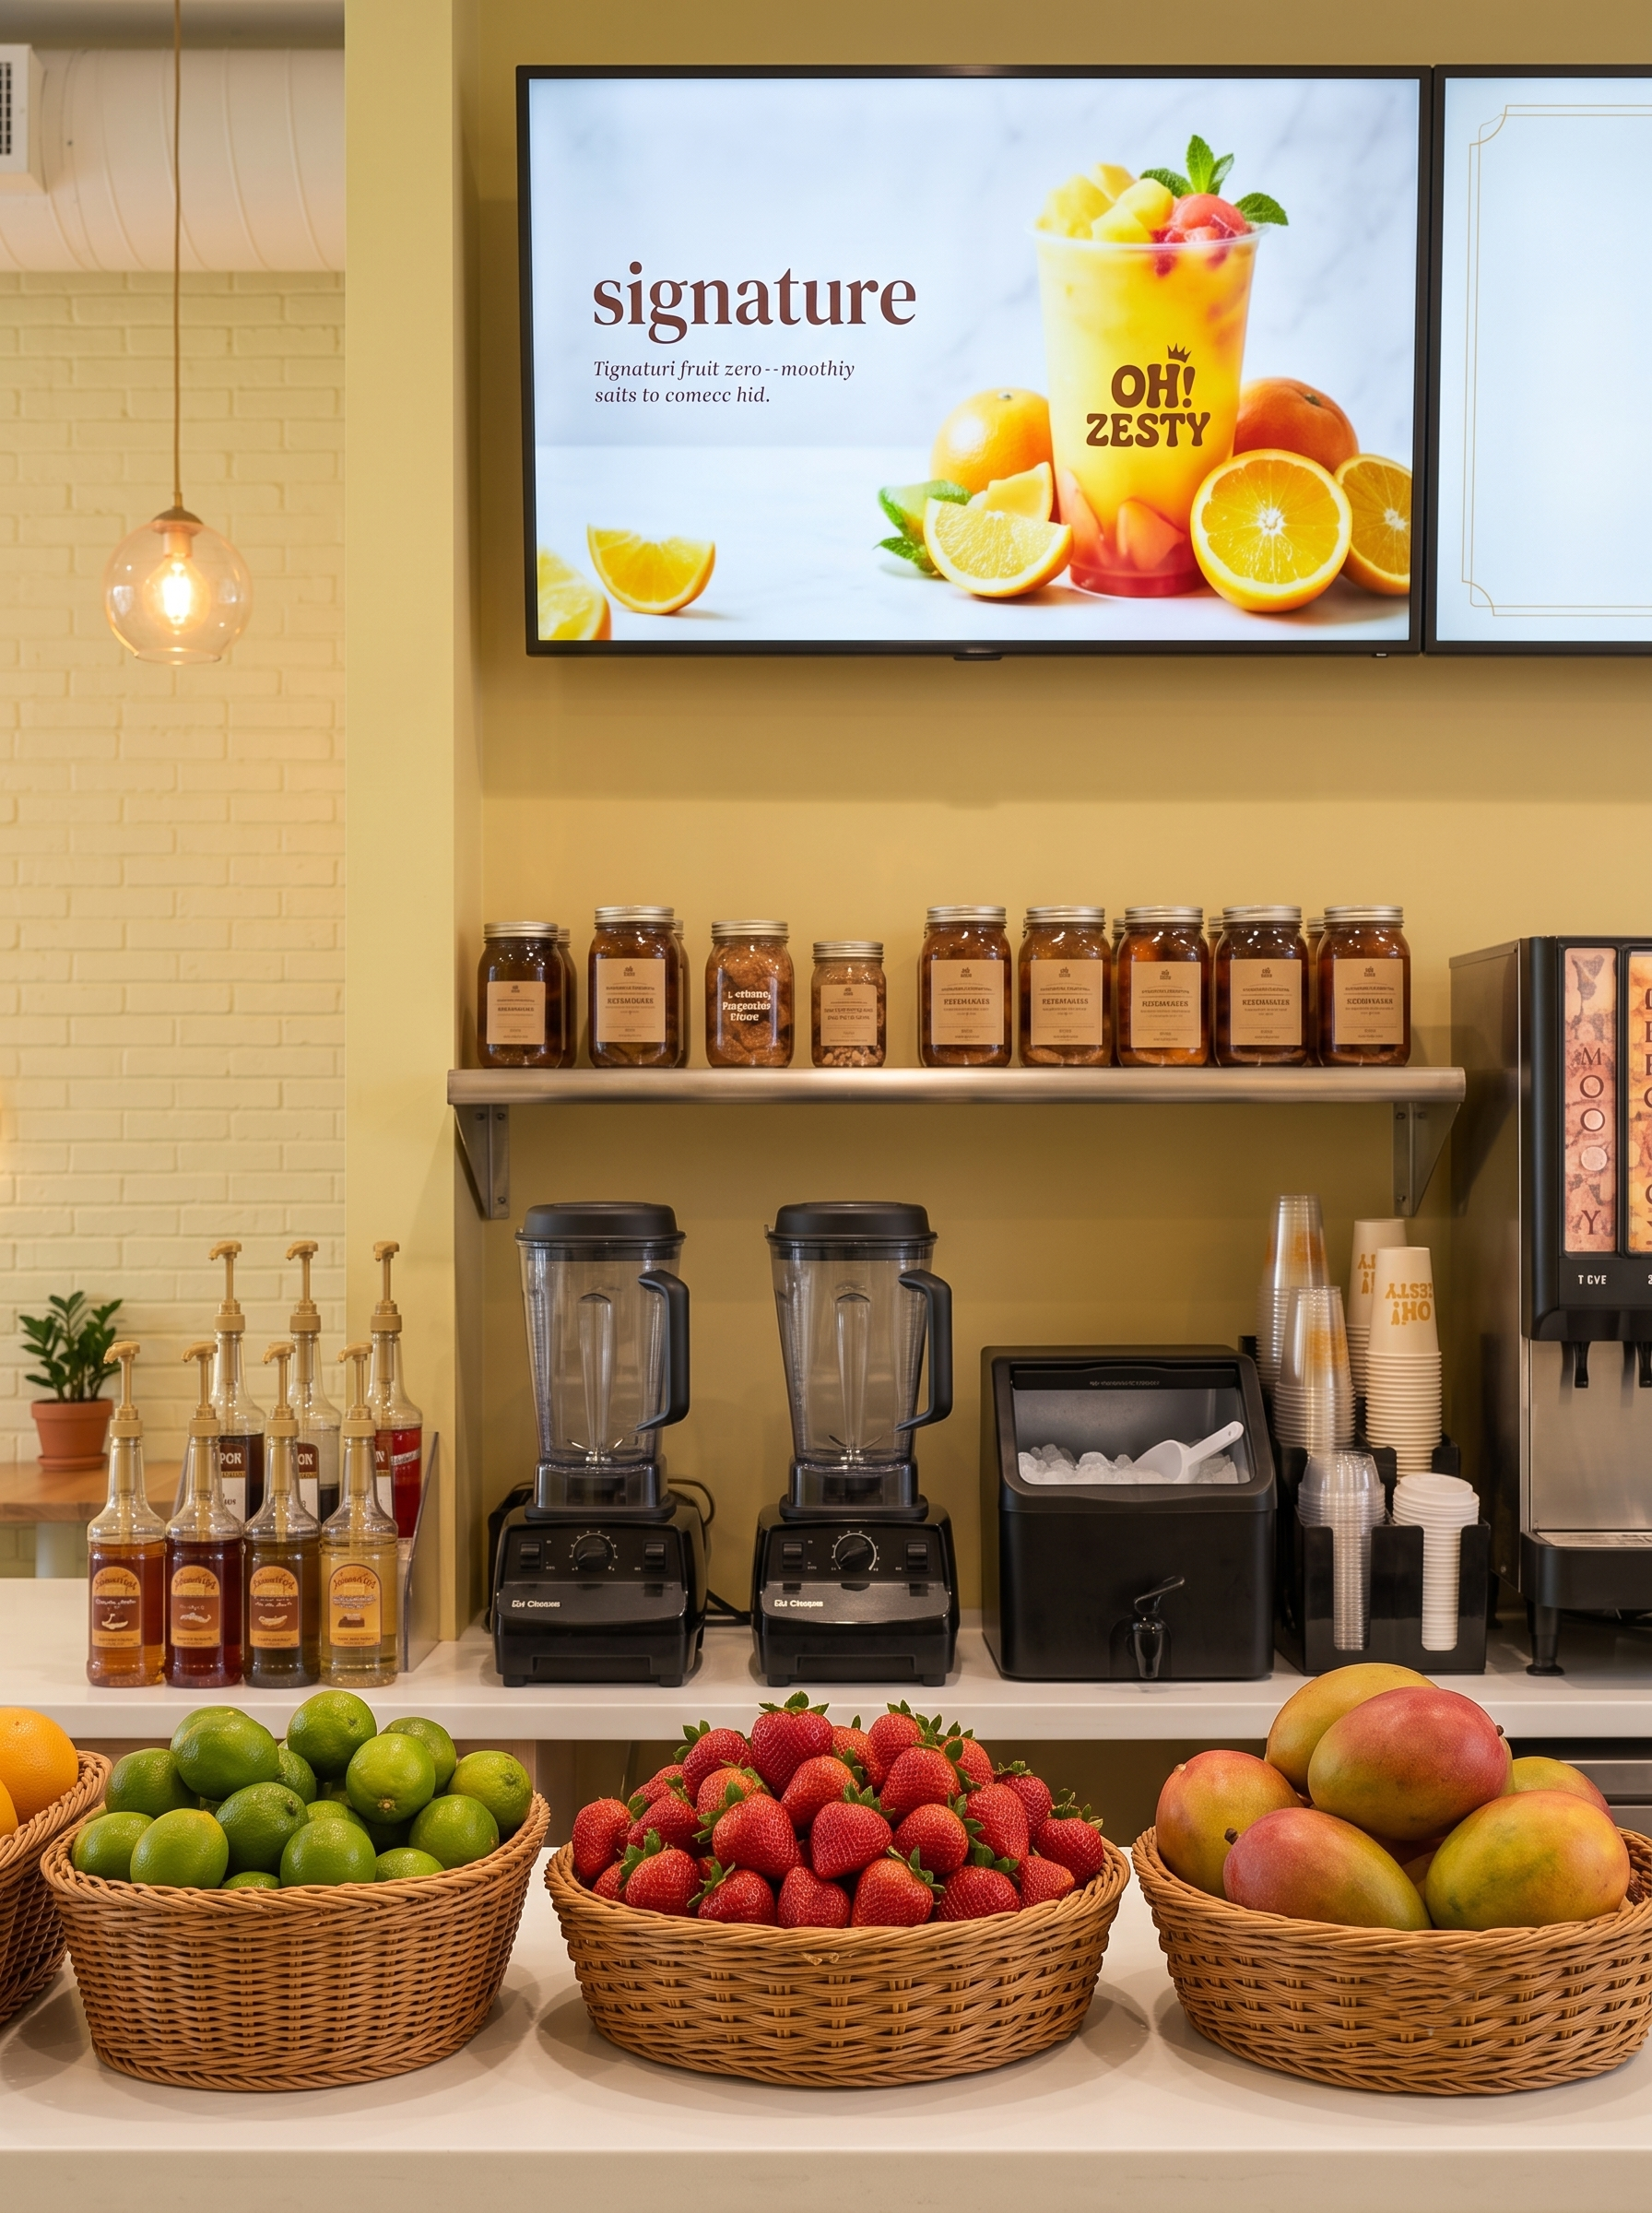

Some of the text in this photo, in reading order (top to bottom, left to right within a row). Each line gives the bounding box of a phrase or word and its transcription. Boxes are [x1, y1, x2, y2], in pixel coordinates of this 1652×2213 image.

[593, 260, 916, 345] signature
[593, 360, 675, 381] Tignaturi
[677, 360, 720, 381] fruit
[1111, 363, 1196, 408] OH!
[595, 385, 771, 403] saits to comecc hid.
[1085, 411, 1211, 448] ZESTY
[1390, 1301, 1432, 1325] OH!
